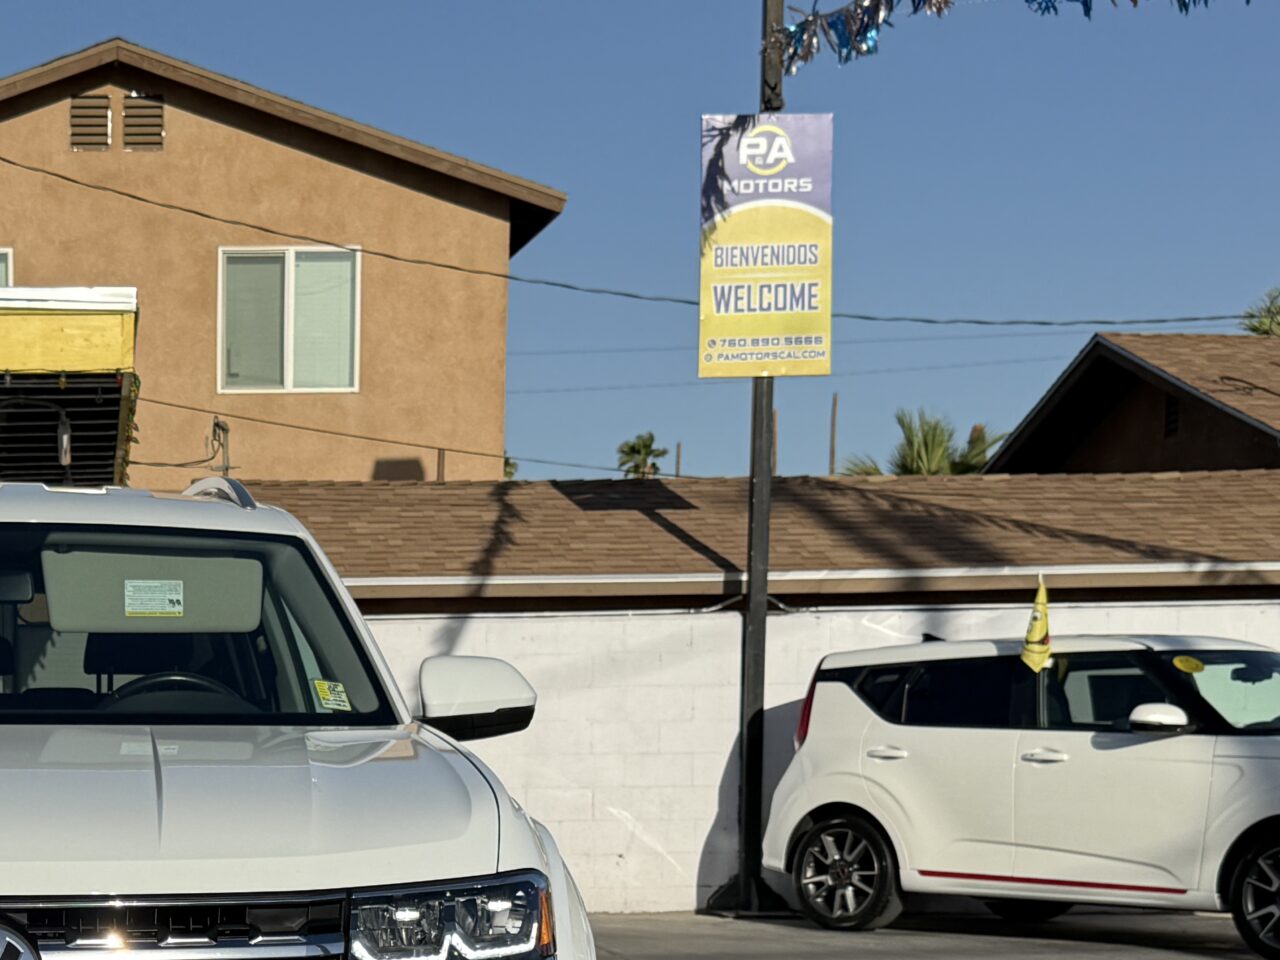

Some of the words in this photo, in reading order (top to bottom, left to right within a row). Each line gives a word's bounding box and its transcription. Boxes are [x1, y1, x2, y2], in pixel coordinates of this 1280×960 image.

[722, 177, 813, 194] MOTORS
[713, 244, 818, 268] BIENVENIDOS
[713, 282, 819, 314] WELCOME
[716, 350, 826, 362] PAMOTORSCAL.COM
